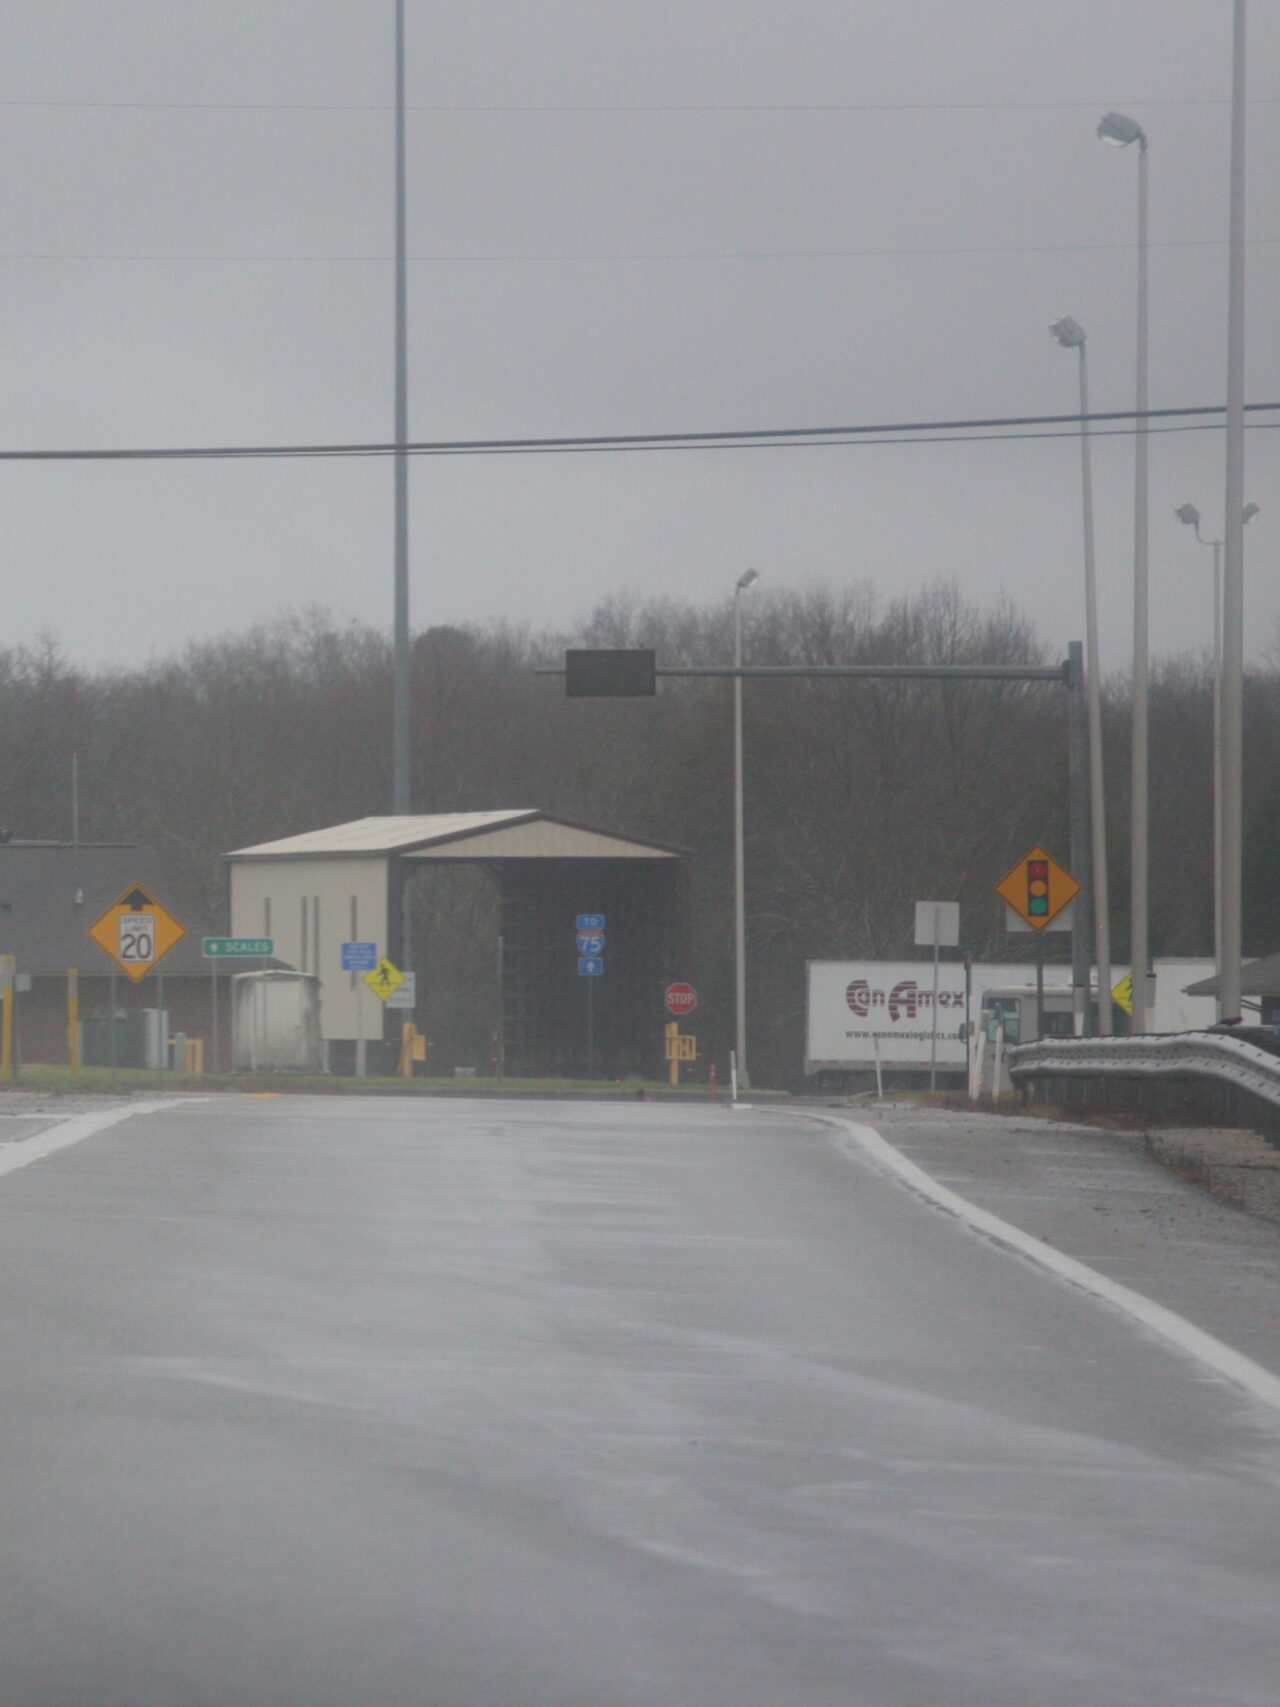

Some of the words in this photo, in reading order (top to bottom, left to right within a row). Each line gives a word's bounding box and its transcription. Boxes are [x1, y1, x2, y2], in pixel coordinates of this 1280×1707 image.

[122, 916, 153, 925] SPEED
[584, 917, 598, 926] TO
[122, 933, 152, 960] 20
[224, 941, 269, 953] SCALES
[580, 936, 602, 952] 75
[668, 991, 696, 1005] STOP
